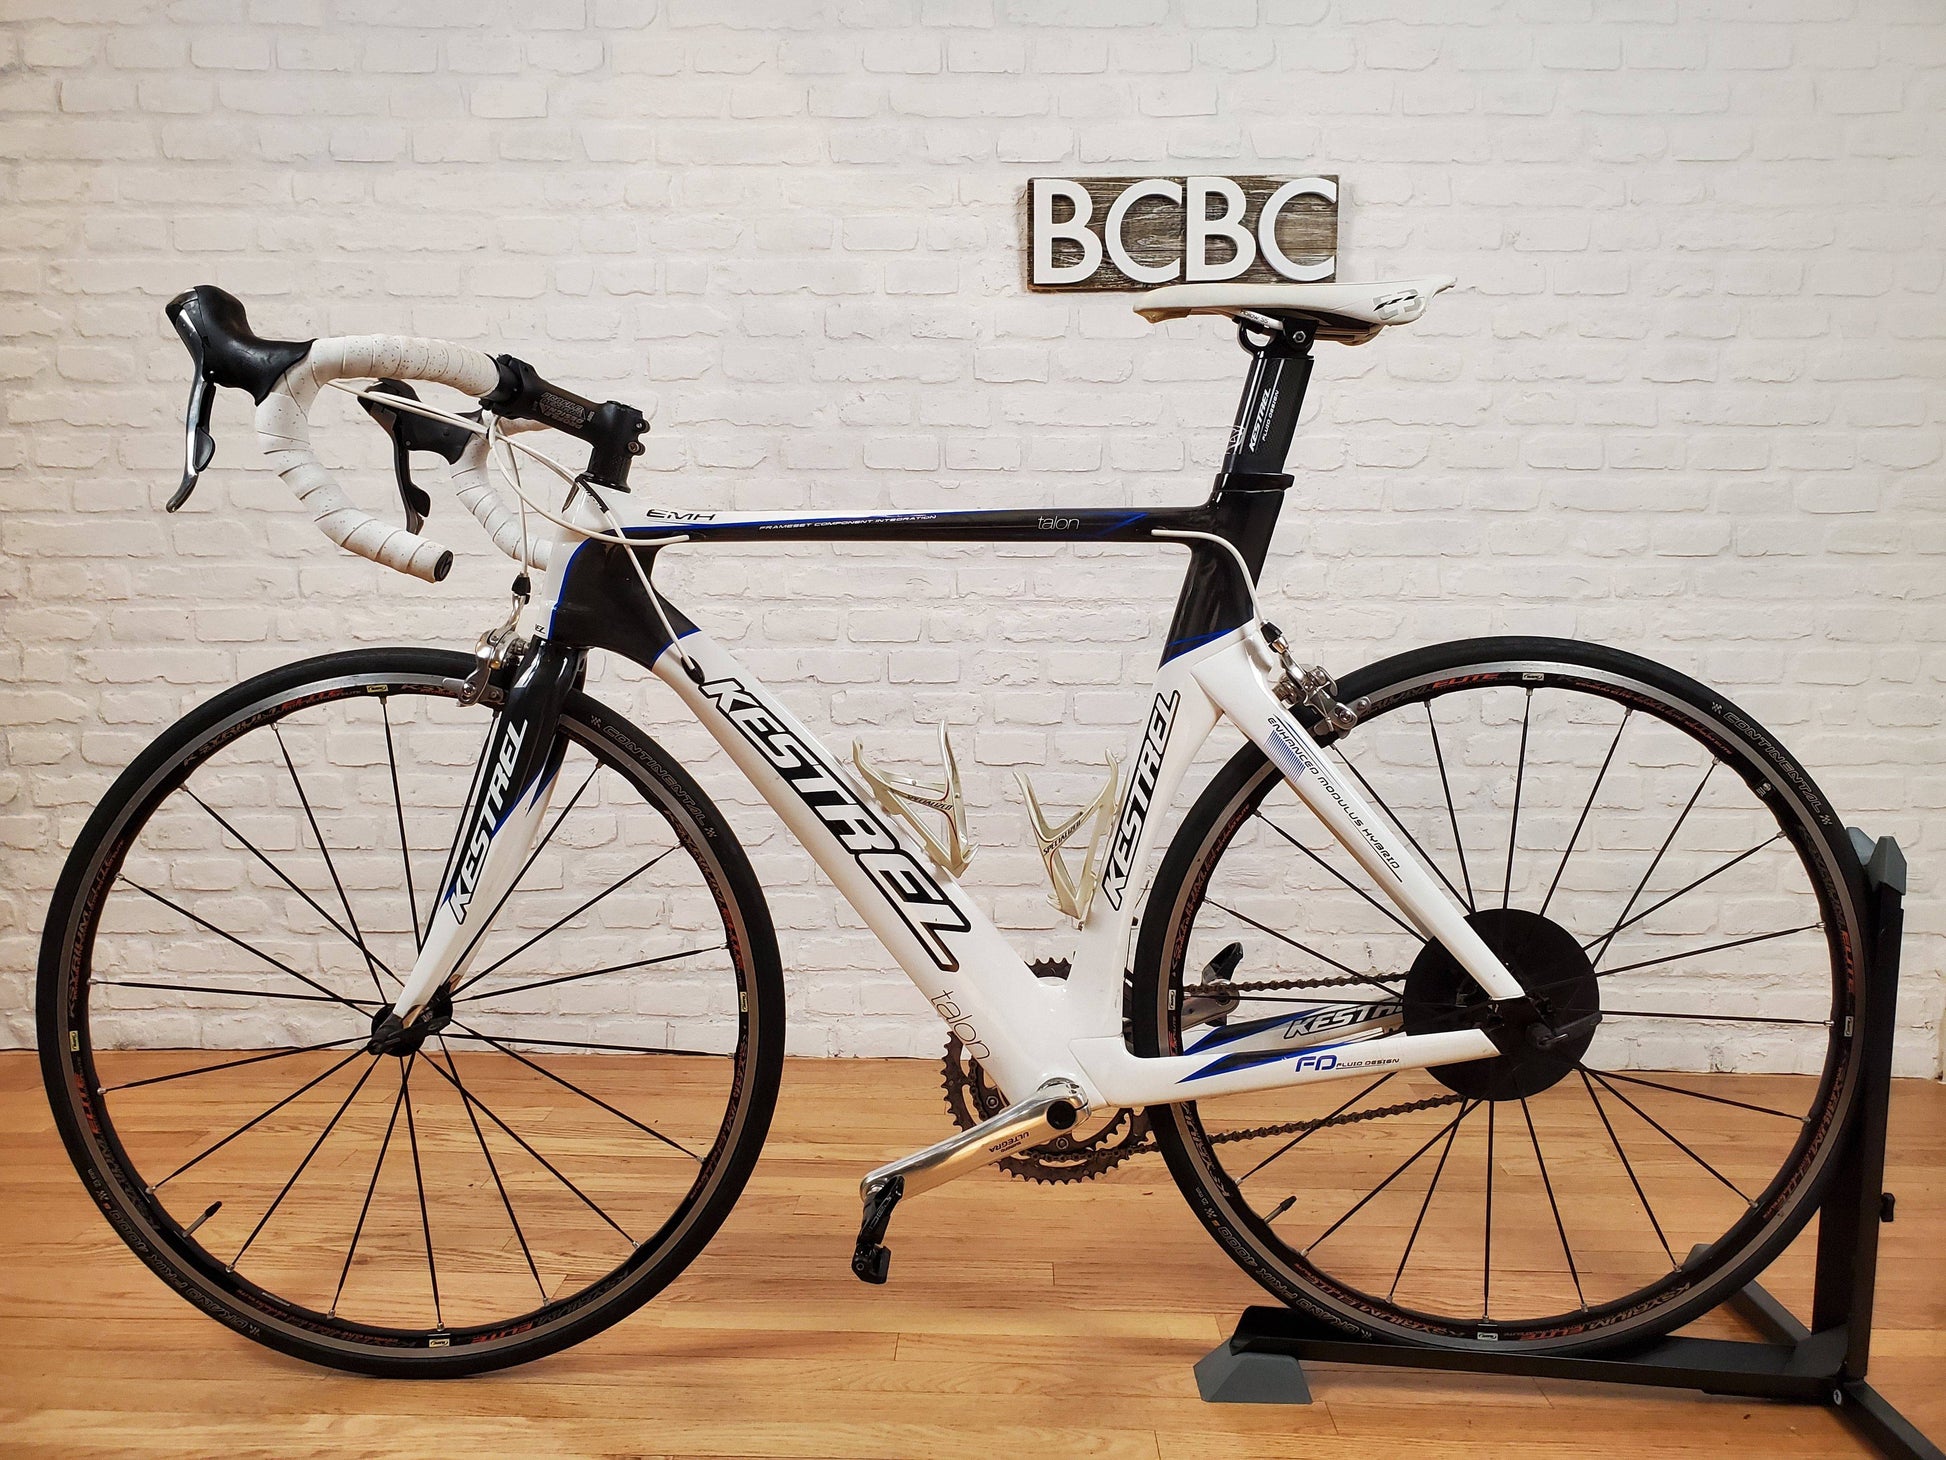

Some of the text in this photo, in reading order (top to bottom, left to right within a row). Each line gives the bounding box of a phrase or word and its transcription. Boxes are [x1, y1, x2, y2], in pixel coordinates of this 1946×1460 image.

[1033, 176, 1336, 284] BCBC
[1249, 388, 1271, 453] KESTREL
[646, 508, 717, 521] EMH
[814, 518, 874, 527] COMPONENT
[875, 514, 937, 523] INTEGRATION
[1037, 515, 1080, 530] talon
[601, 722, 709, 827] CONTINENTAL
[1721, 708, 1826, 815] CONTINENTAL
[906, 794, 953, 811] SPECIALIZED
[1102, 690, 1181, 911] KESTREL
[1267, 717, 1400, 870] ENHANCED MODULUS HYBRID
[449, 719, 528, 925] KESTREL
[698, 678, 971, 973] KESTREL
[1043, 820, 1081, 855] SPECIALIZED
[931, 990, 990, 1059] talon
[1284, 1003, 1403, 1039] KESTR
[1364, 1058, 1400, 1066] DESIGN
[989, 1131, 1029, 1152] ULTEGRA
[1216, 1223, 1260, 1270] 4000
[146, 1251, 189, 1291] PRIX
[1253, 1264, 1299, 1301] PRIX
